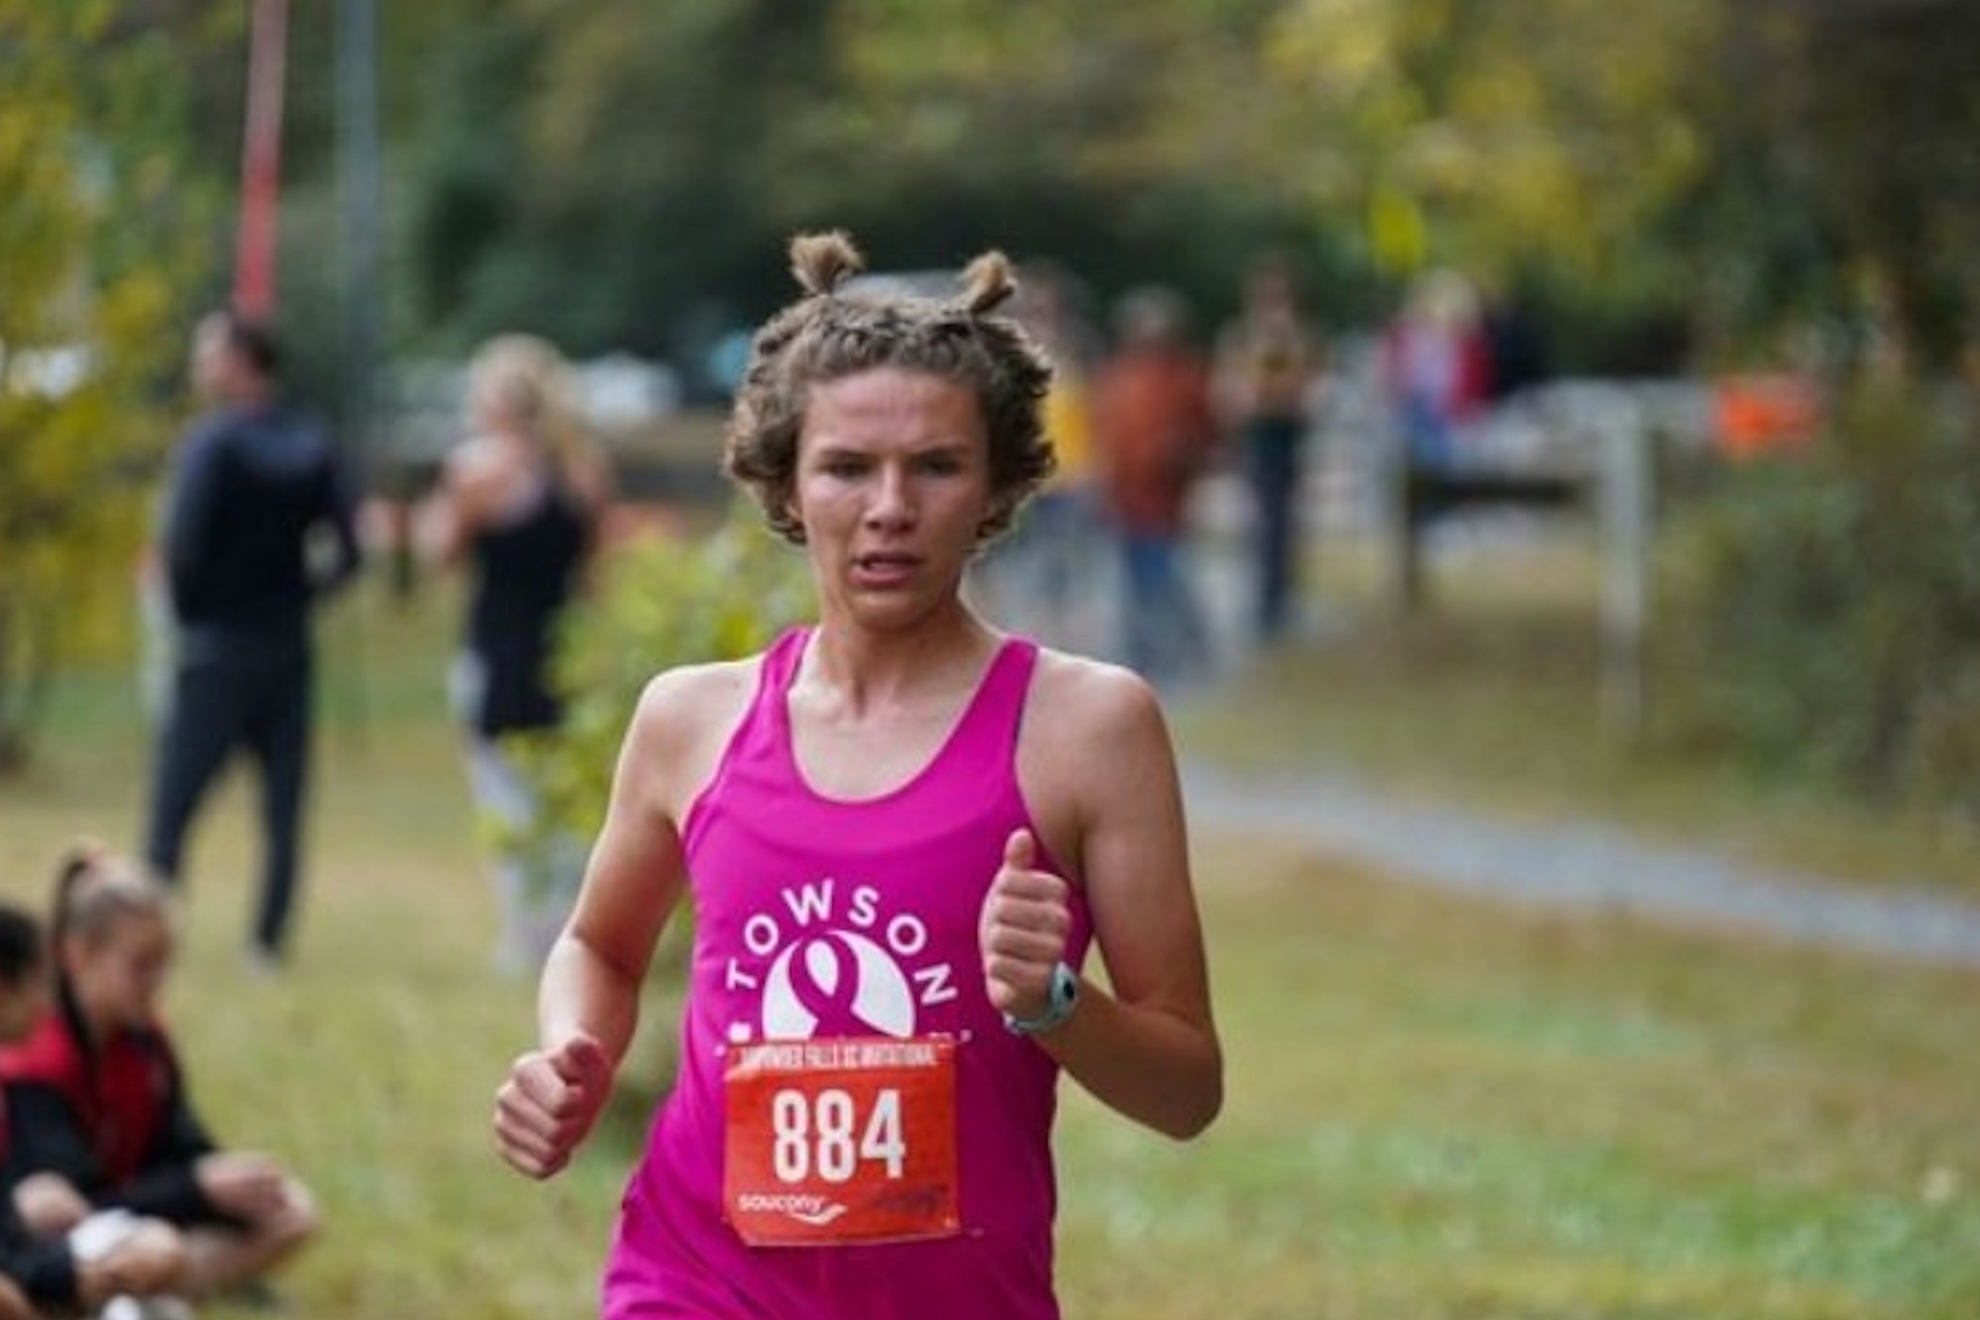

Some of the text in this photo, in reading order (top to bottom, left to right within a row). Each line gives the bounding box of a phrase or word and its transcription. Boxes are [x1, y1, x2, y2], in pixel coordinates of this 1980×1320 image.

[727, 878, 958, 1006] TOWSON
[773, 1088, 905, 1184] 884
[738, 1194, 824, 1214] saucony
